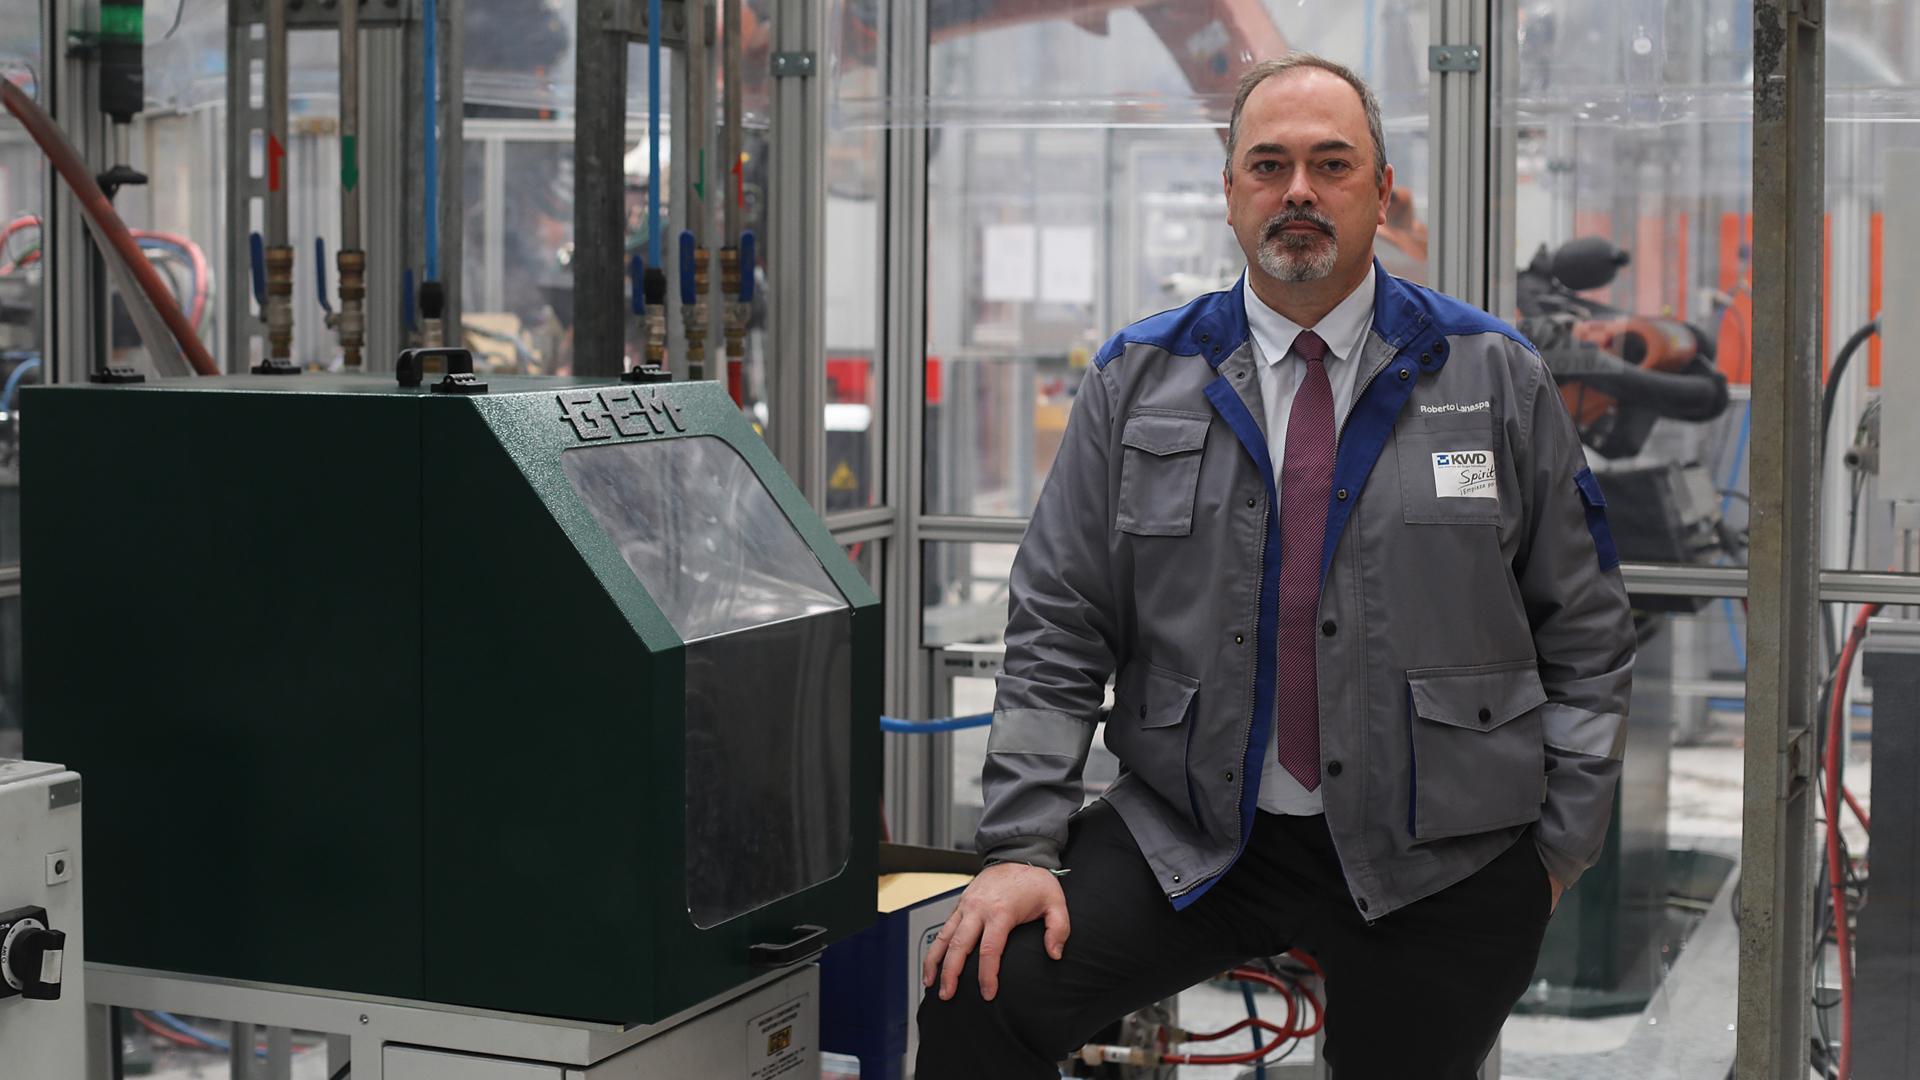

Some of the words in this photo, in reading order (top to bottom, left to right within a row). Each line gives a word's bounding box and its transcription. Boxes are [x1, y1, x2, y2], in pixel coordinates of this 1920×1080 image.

[556, 388, 687, 441] GEM
[1420, 403, 1456, 413] Roberto
[1456, 401, 1490, 413] Lanaspa
[1451, 453, 1487, 465] KWD
[1459, 464, 1496, 485] Spirit
